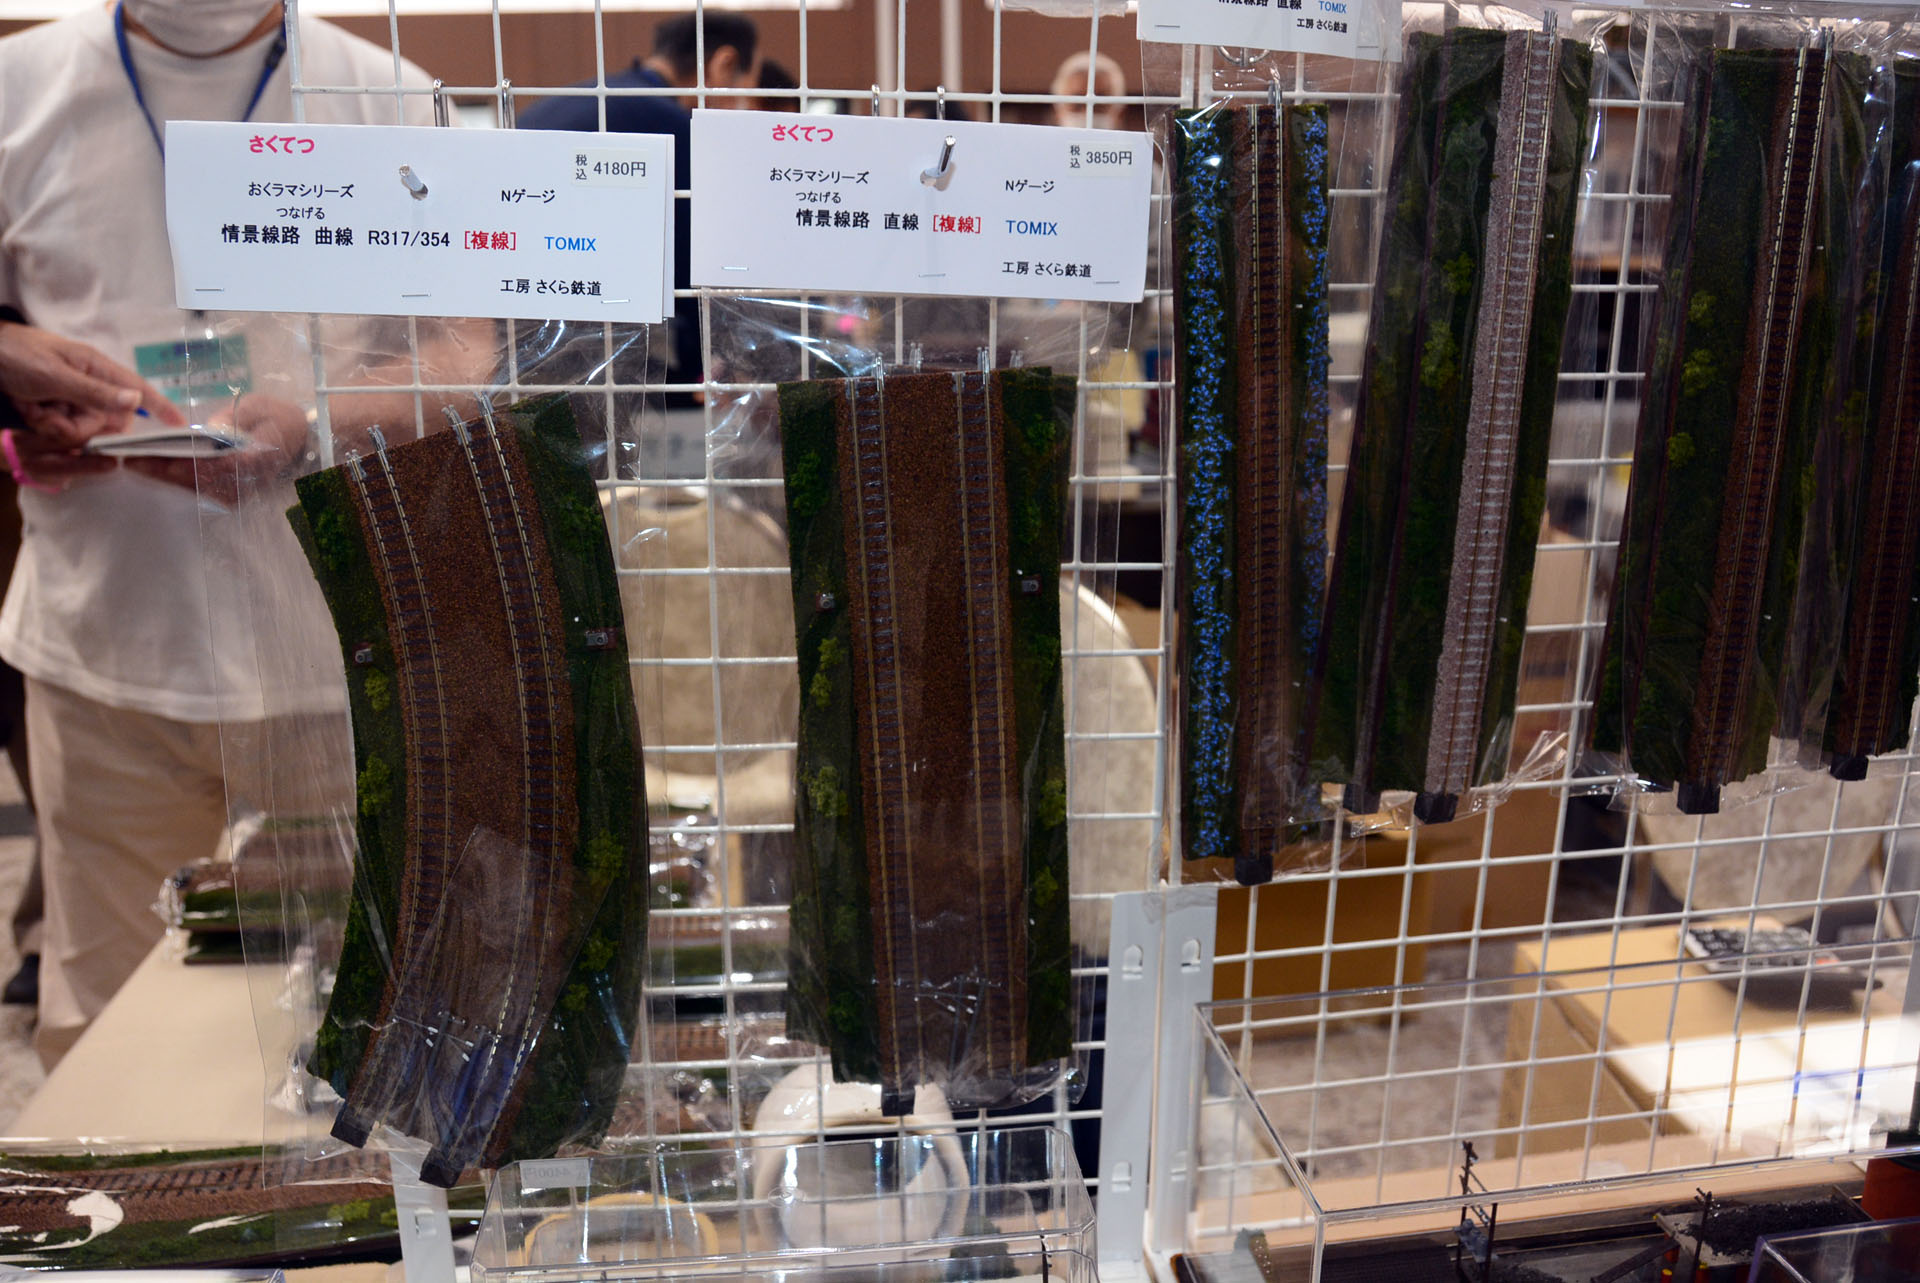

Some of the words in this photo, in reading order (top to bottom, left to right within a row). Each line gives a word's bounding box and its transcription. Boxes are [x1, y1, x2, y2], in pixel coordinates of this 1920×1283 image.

[1319, 1, 1346, 13] TOMIX
[1297, 18, 1314, 29] 工房
[1316, 19, 1347, 33] さくら鉄道
[772, 124, 833, 142] さくてつ
[250, 134, 314, 153] さくてつ
[1086, 151, 1132, 165] 3850円
[594, 162, 645, 177] 4180円
[770, 168, 869, 184] おくラマシリーズ
[249, 182, 354, 198] おくラマシリーズ
[1006, 180, 1054, 193] Nゲージ
[502, 189, 555, 203] Nゲージ
[796, 191, 841, 203] つなげる
[277, 207, 325, 220] つなげる
[796, 208, 869, 228] 情景線路
[884, 213, 918, 231] 直線
[933, 215, 981, 233] [複線]
[1006, 220, 1057, 235] TOMIX
[221, 224, 300, 244] 情景線路
[316, 226, 353, 246] 曲線
[369, 230, 450, 246] R317/354
[465, 231, 516, 250] [複線]
[544, 237, 596, 251] TOMIX
[1002, 261, 1029, 275] 工房
[1035, 262, 1091, 277] さくら鉄道
[501, 279, 530, 293] 工房
[537, 280, 601, 296] さくら鉄道
